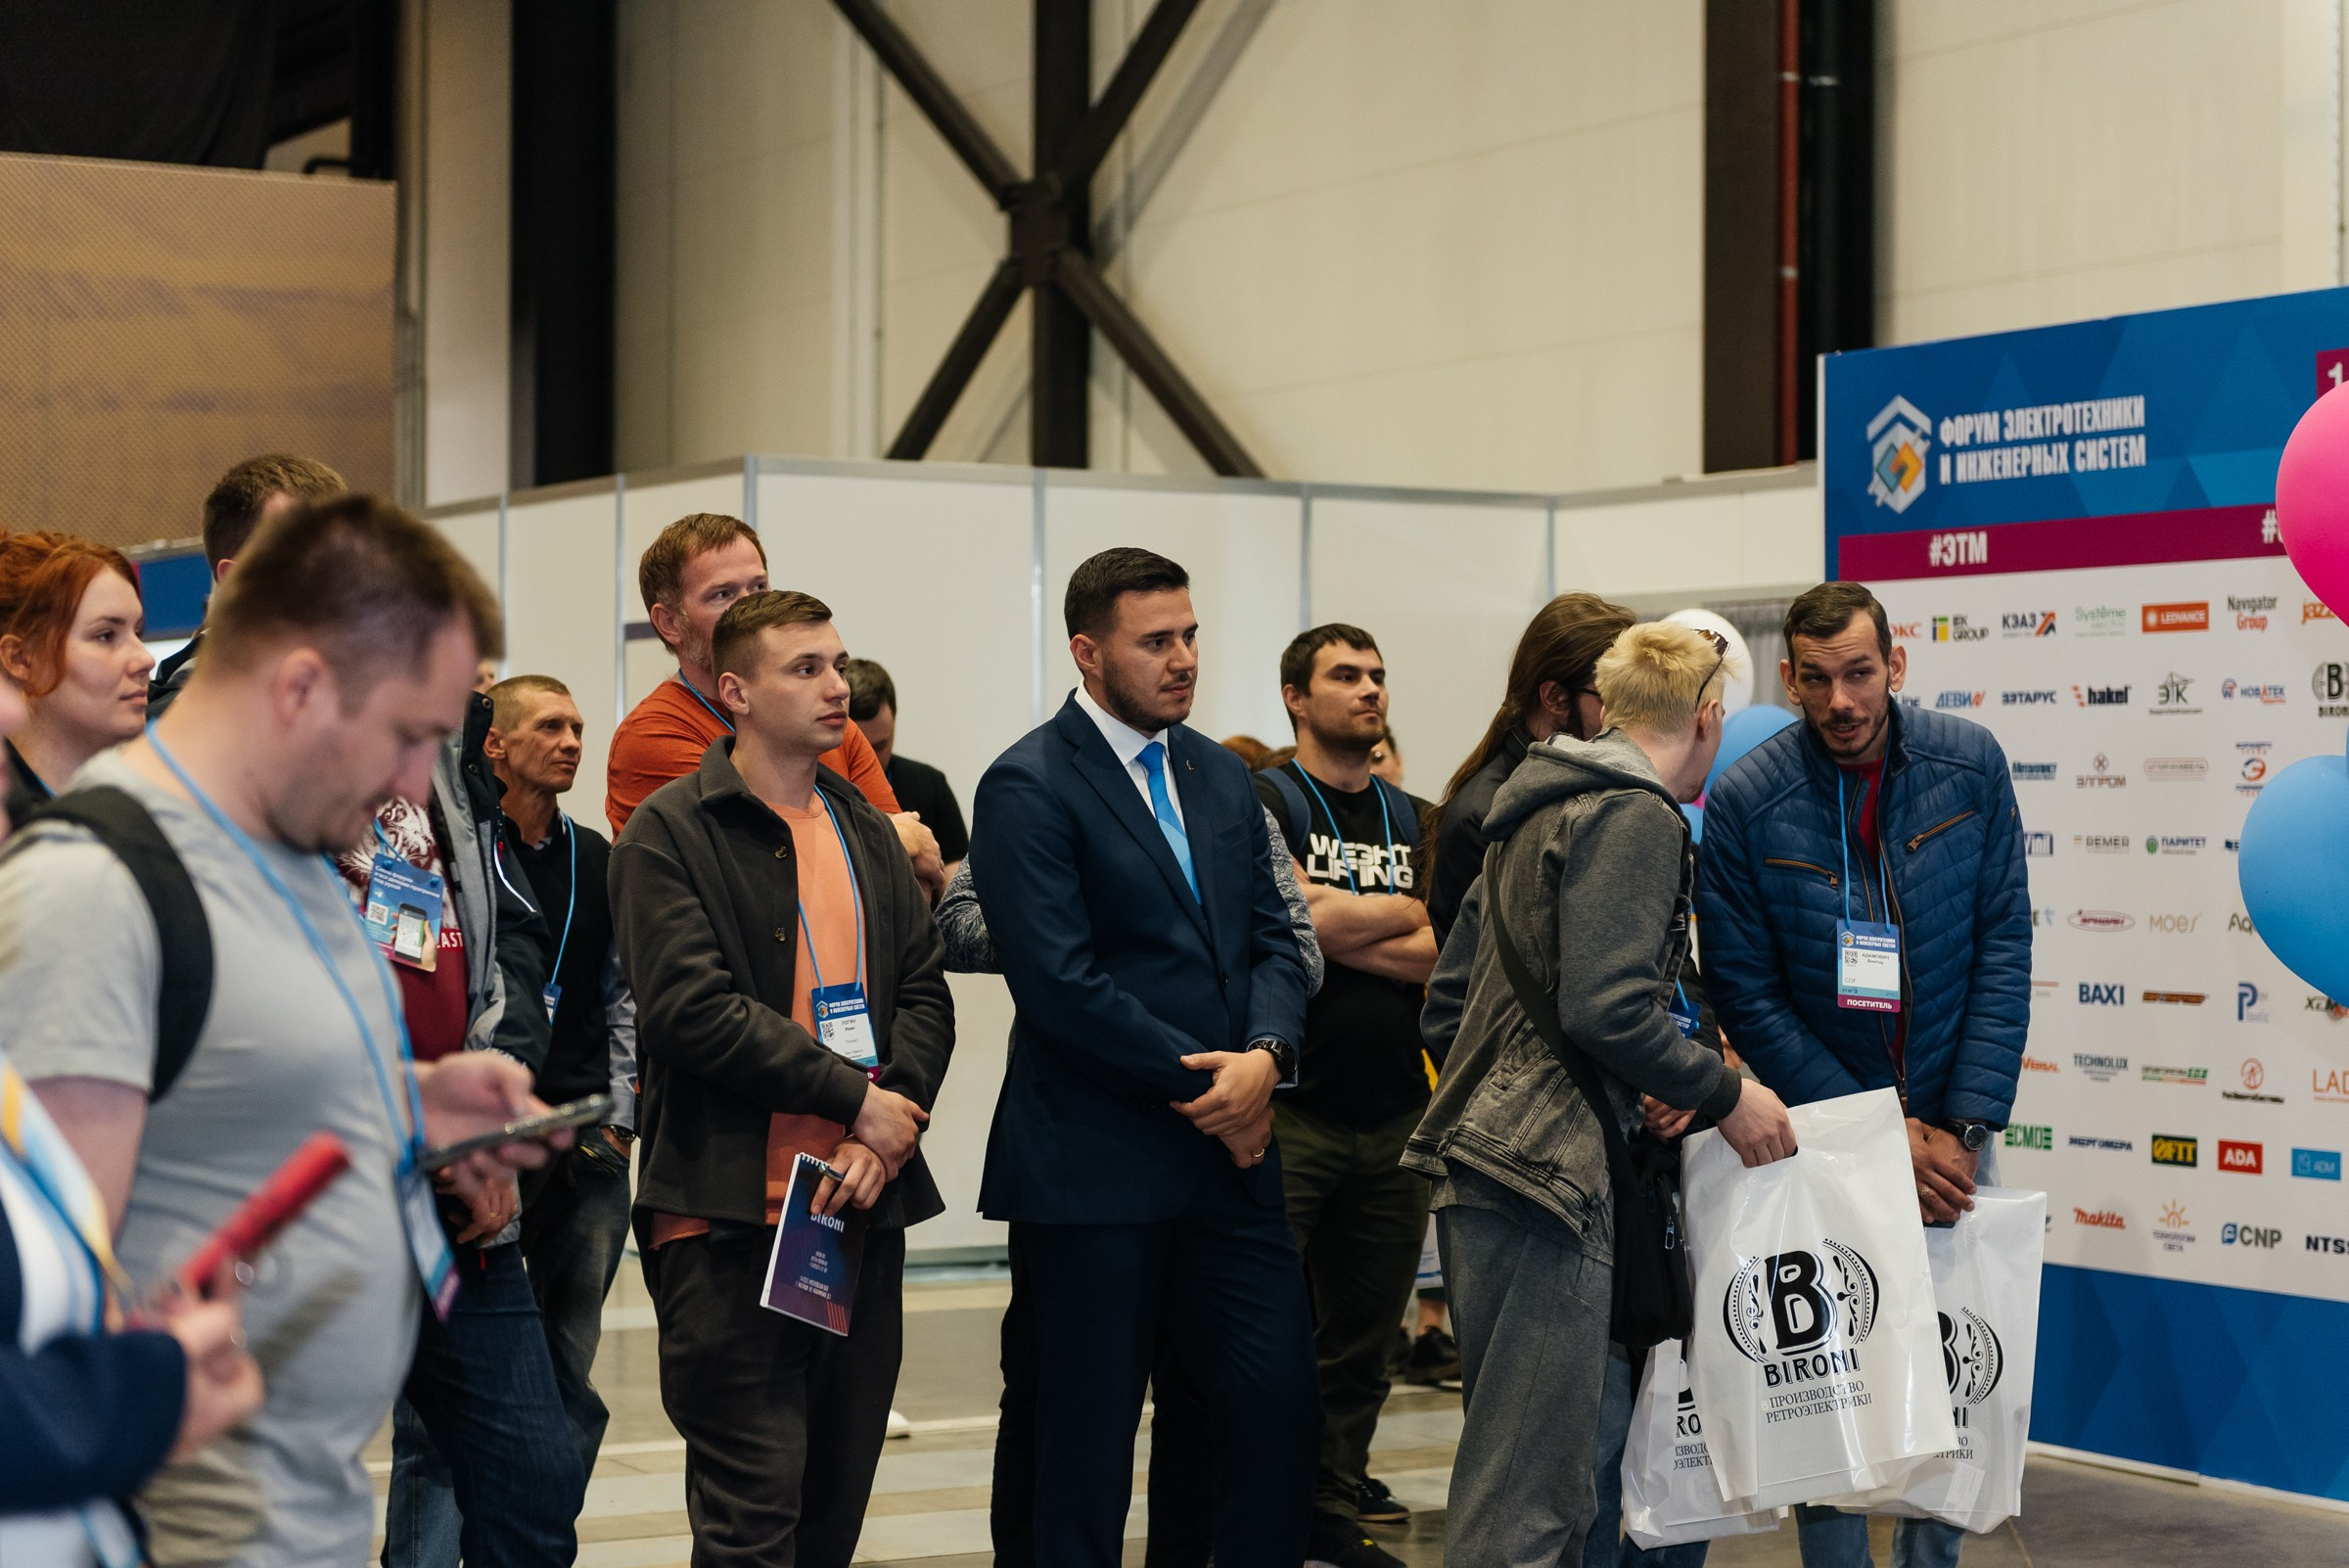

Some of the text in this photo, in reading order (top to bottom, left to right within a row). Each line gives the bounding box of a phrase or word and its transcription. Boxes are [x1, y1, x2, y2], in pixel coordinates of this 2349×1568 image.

[1939, 394, 2145, 447] ФОРУМ ЭЛЕКТРОТЕХНИКИ
[1939, 434, 2146, 485] И ИНЖЕНЕРНЫХ СИСТЕМ
[1929, 531, 1988, 567] #ЭТМ
[2228, 595, 2278, 614] Navigator
[2003, 613, 2037, 630] КЭАЗ
[2161, 610, 2206, 624] LEDVANCE
[2236, 614, 2268, 632] Group
[2087, 686, 2129, 705] hakel
[2161, 837, 2206, 848] ПАРИТЕТ
[1847, 998, 1893, 1009] ПОСЕТИТЕЛЬ
[2078, 982, 2125, 1006] BAXI
[2073, 1053, 2129, 1071] TECHNOLUX
[2224, 1148, 2257, 1168] ADA
[2239, 1224, 2281, 1249] CNP
[2306, 1234, 2349, 1255] NTS
[1763, 1347, 1861, 1389] BIRONI
[1770, 1380, 1865, 1409] ПРОИЗВОДСТВО
[1766, 1393, 1872, 1424] РЕТРОЭЛЕКТРИКИ
